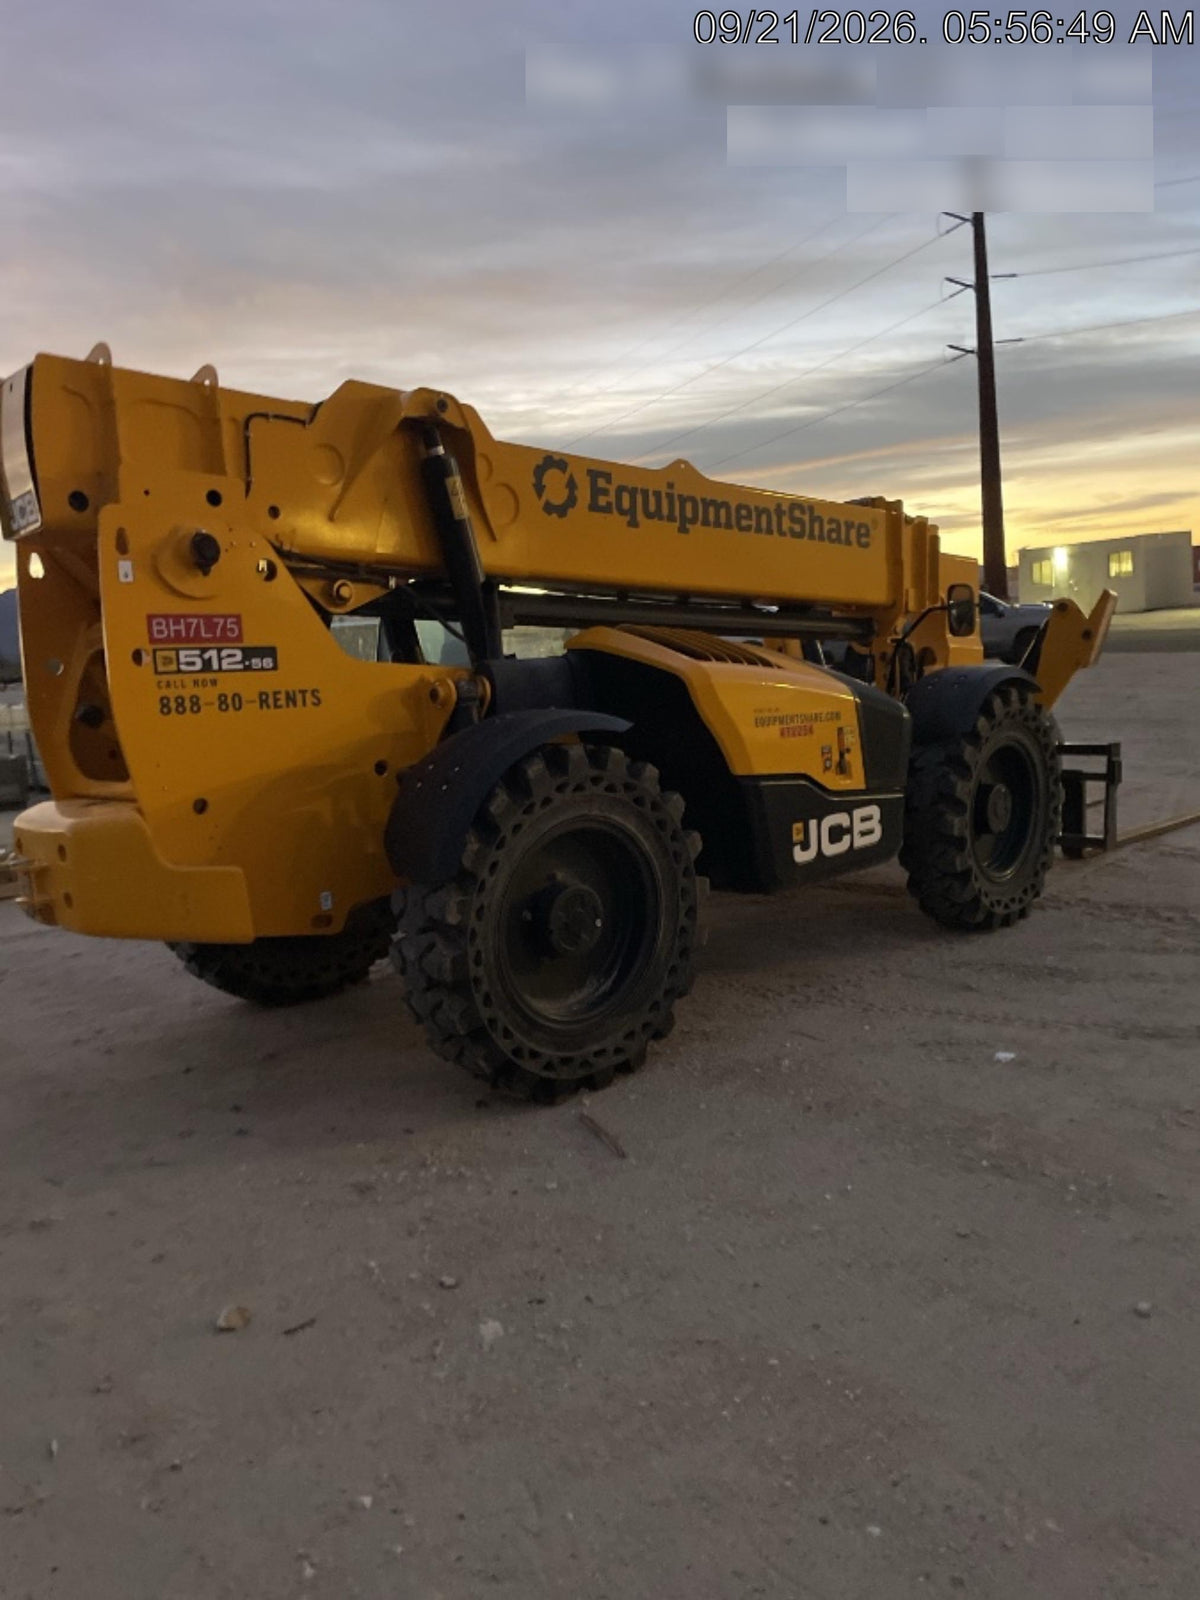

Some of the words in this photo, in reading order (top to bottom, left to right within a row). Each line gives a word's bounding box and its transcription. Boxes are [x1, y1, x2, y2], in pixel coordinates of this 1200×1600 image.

[586, 468, 872, 549] EquipmentShare
[151, 617, 240, 639] BH7L75
[157, 679, 187, 690] CALL
[193, 677, 218, 688] NOW
[159, 688, 322, 716] 888-80-RENTS
[792, 804, 883, 864] JCB
